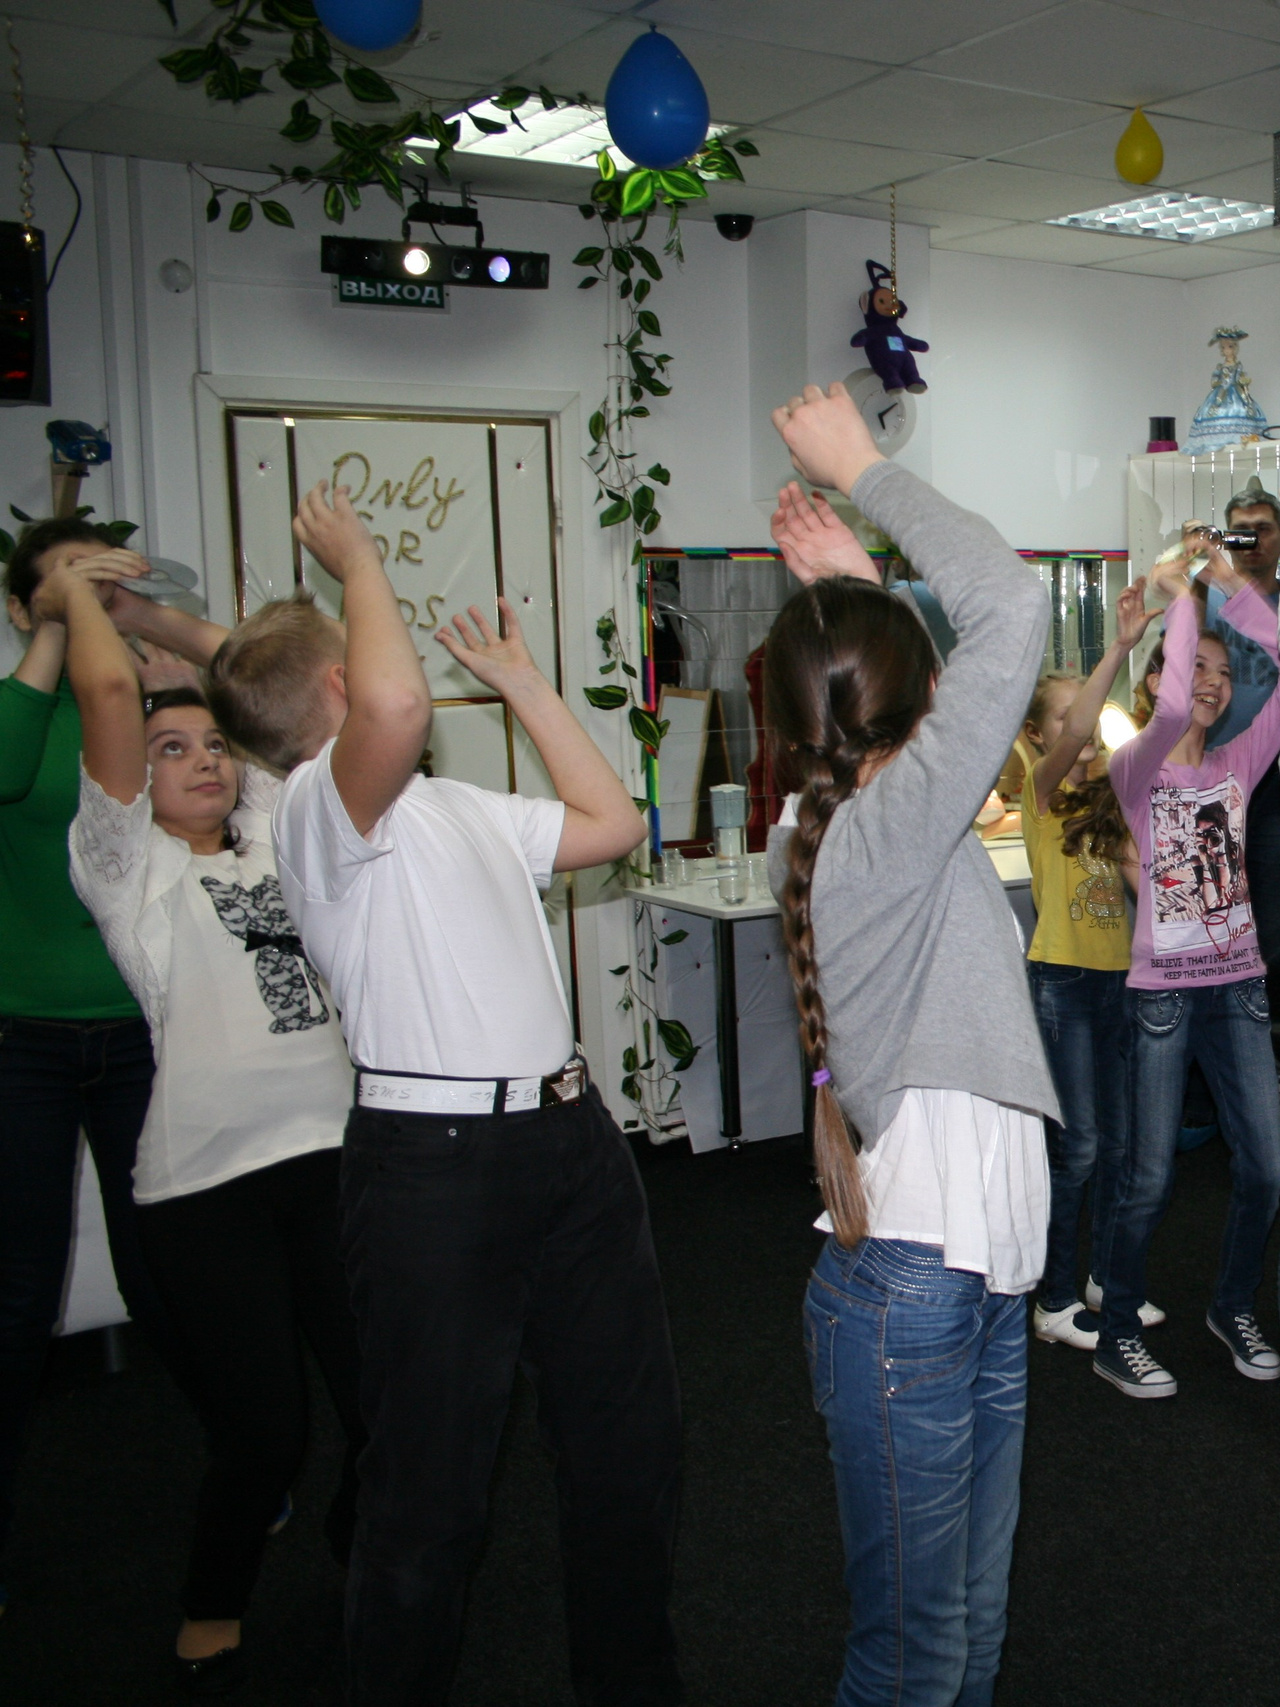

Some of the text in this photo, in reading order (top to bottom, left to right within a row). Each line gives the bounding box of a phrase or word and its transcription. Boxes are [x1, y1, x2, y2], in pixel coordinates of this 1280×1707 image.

[341, 280, 440, 304] ВЫХОД
[332, 452, 465, 529] Only
[1187, 954, 1209, 967] THAT
[1164, 971, 1182, 981] KEEP
[1183, 968, 1197, 979] THE
